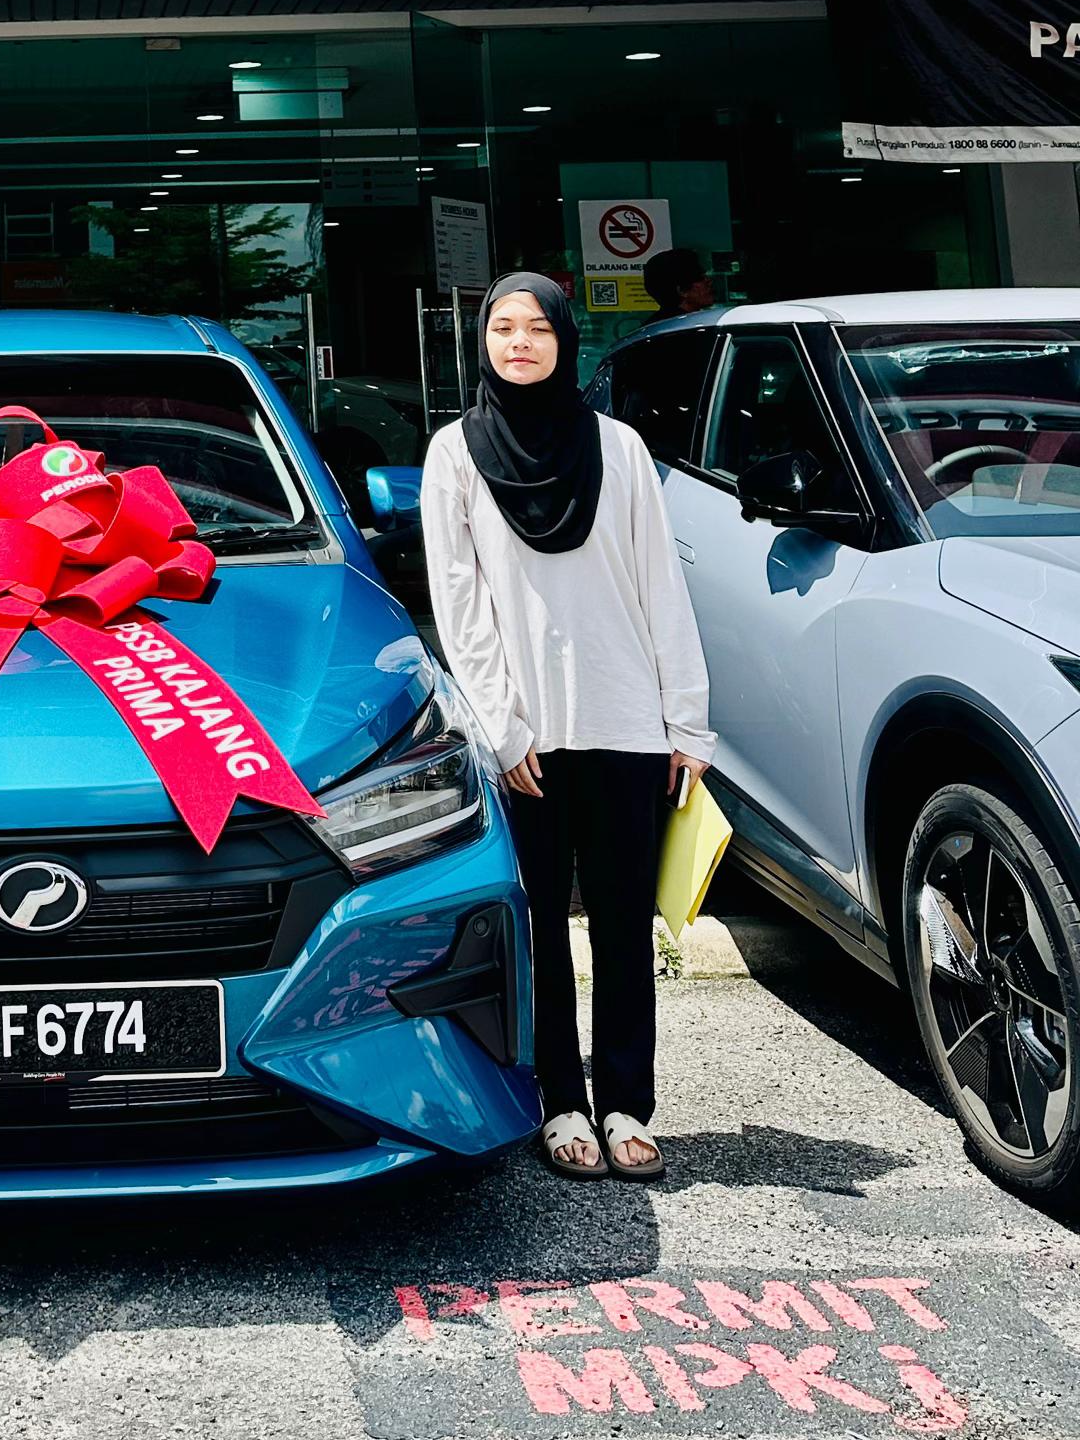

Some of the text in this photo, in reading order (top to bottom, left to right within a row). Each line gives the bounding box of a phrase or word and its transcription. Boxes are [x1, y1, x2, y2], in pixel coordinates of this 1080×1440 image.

[949, 139, 974, 149] 1800
[976, 139, 988, 149] 88
[990, 139, 1017, 149] 6600
[586, 263, 628, 272] DILARANG
[40, 473, 107, 502] PERODU
[93, 656, 185, 741] PRIMA
[104, 622, 270, 779] PSSB KAJANG
[36, 1000, 147, 1056] 6774
[394, 1277, 949, 1342] PERMIT
